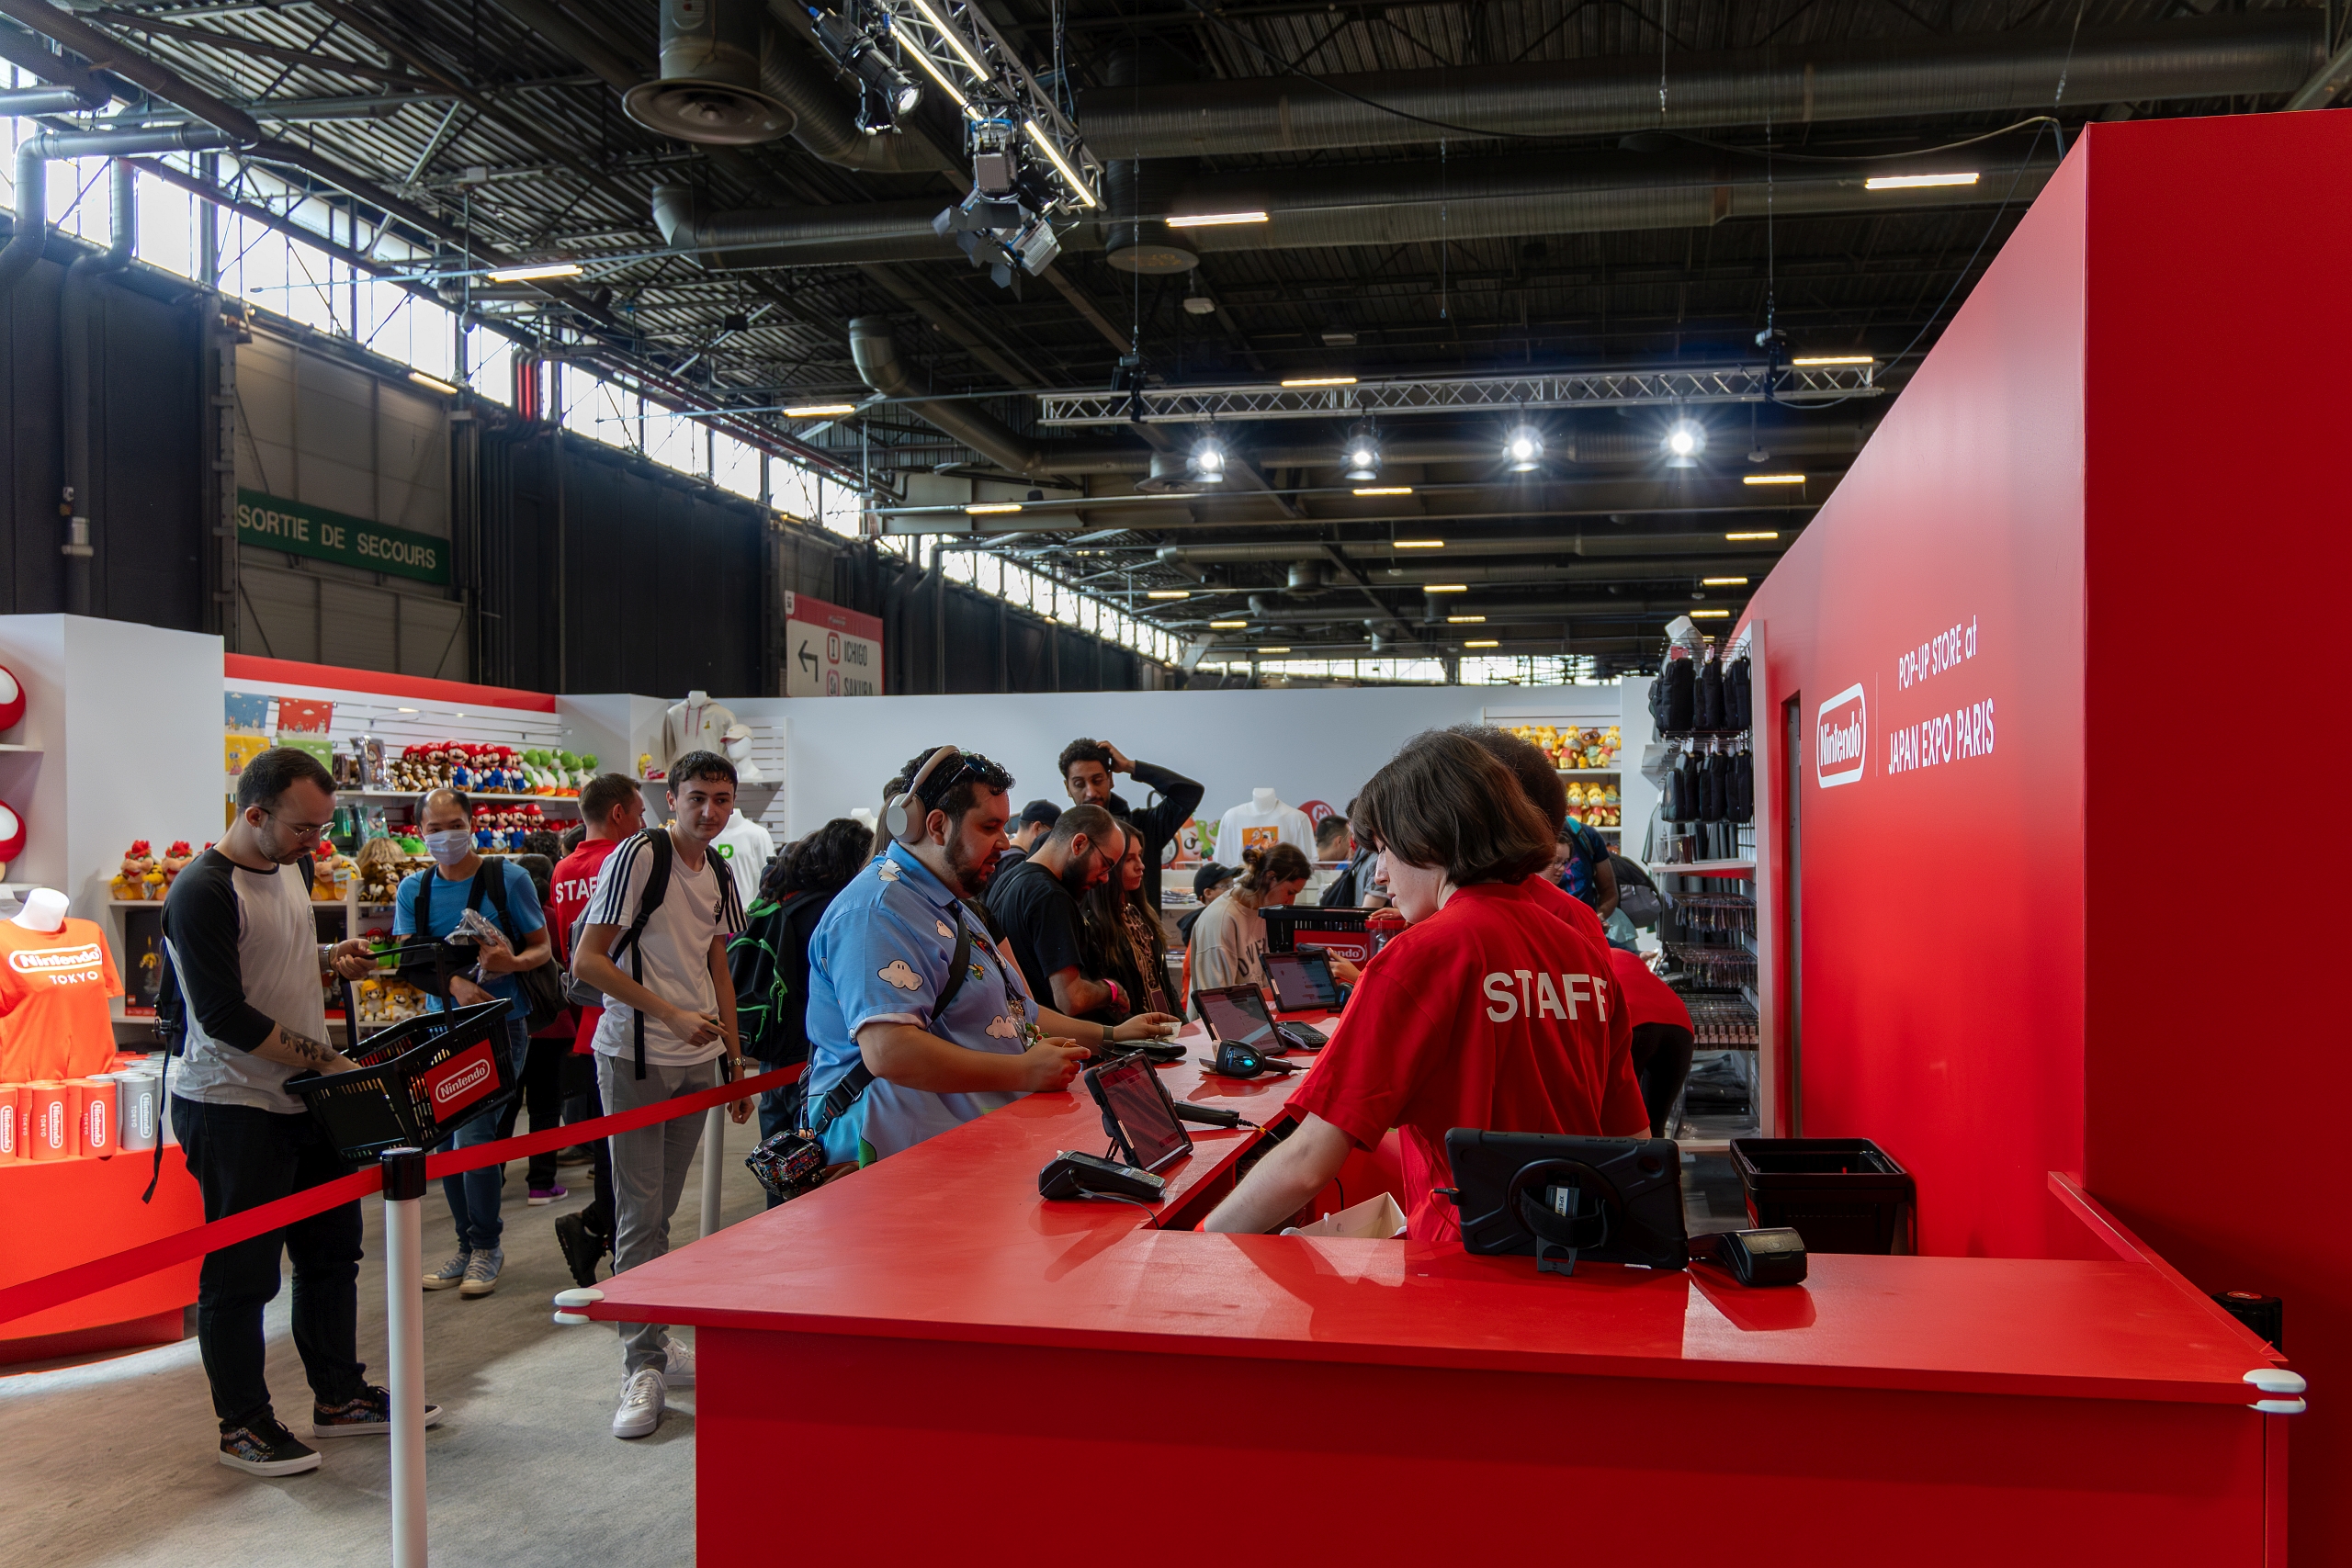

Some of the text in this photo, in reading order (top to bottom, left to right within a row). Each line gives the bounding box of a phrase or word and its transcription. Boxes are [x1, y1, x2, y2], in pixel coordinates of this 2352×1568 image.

[238, 504, 436, 570] SORTIE DE SECOURS
[843, 639, 868, 667] ICHIGO
[1898, 614, 1977, 691] POP-UP STORE at
[843, 677, 873, 696] SAKURA
[1820, 710, 1861, 767] Nintendo
[1888, 697, 1994, 774] JAPAN EXPO PARIS
[555, 876, 597, 904] STAF
[19, 950, 100, 968] Nintendo
[49, 971, 98, 985] TOKYO
[1483, 969, 1608, 1023] STAFF
[439, 1066, 486, 1098] Nintendo
[4, 1109, 12, 1148] Nintendo
[52, 1105, 61, 1145] Nintendo
[94, 1104, 102, 1144] Nintendo
[142, 1096, 151, 1134] Nintendo
